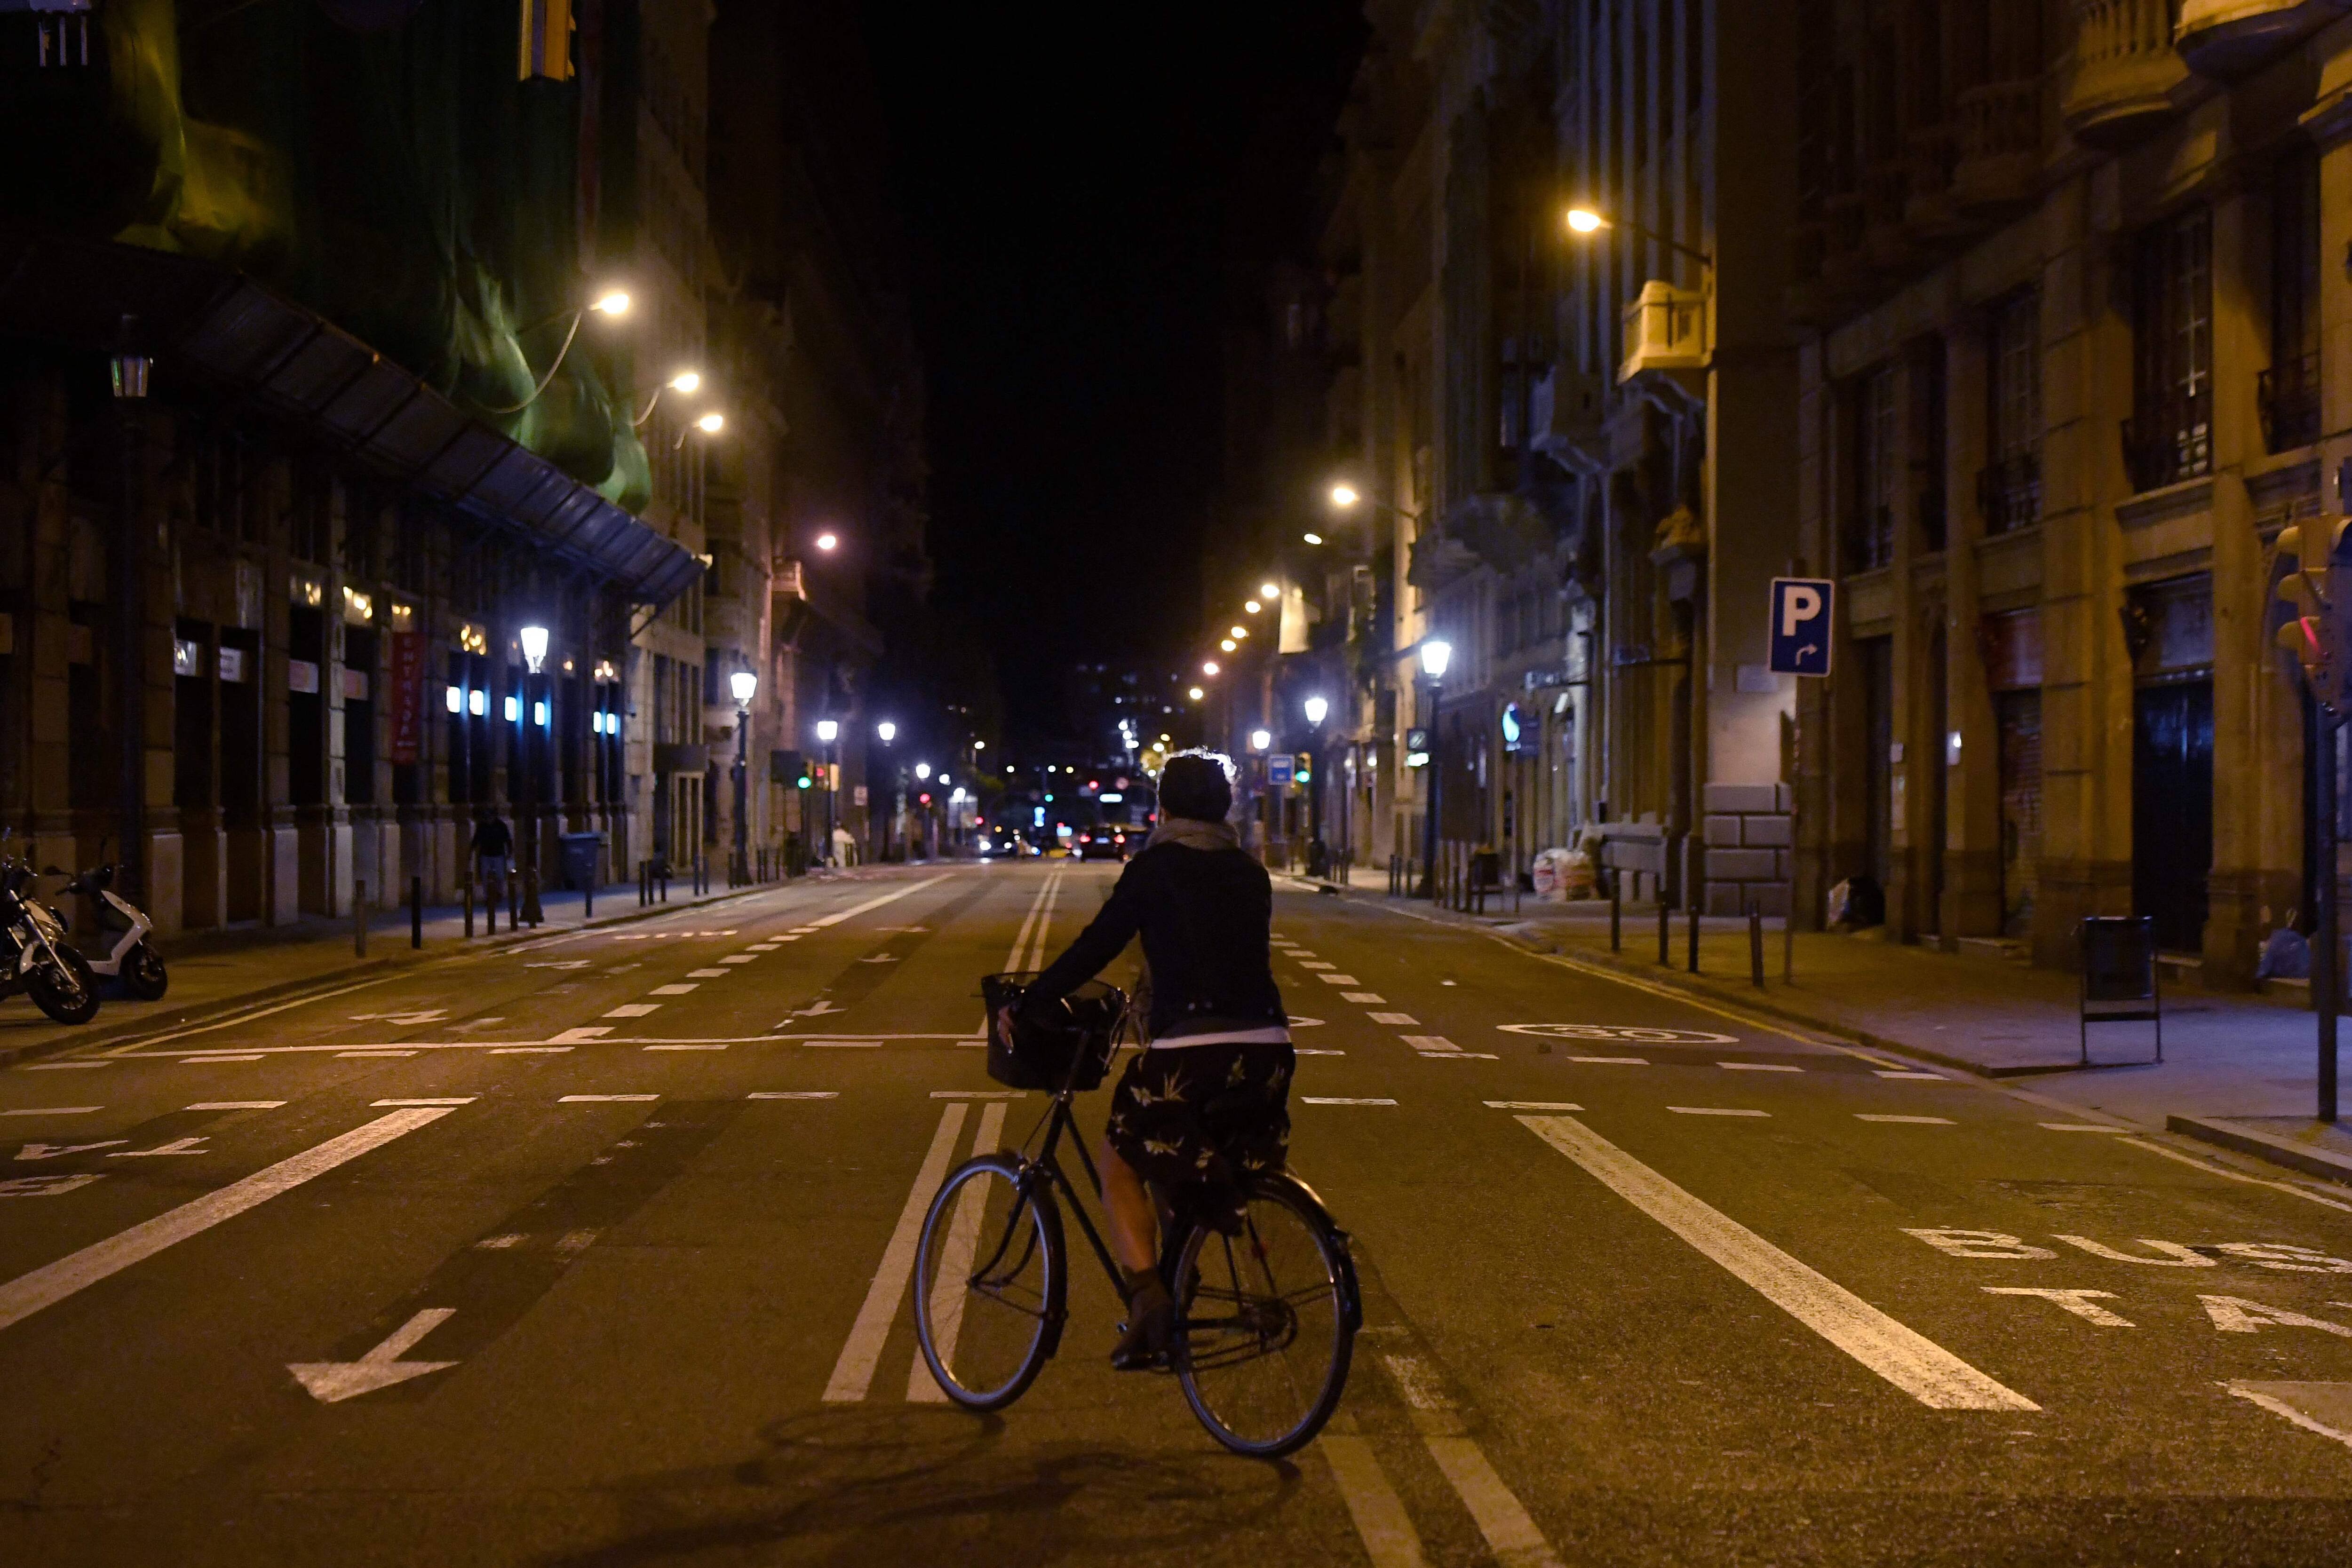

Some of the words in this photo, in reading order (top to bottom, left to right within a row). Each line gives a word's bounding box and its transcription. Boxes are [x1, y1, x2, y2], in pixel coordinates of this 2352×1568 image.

[1782, 586, 1822, 636] P
[1554, 1027, 1678, 1040] 30
[1899, 1227, 2352, 1274] BUS
[1979, 1286, 2352, 1338] TA
